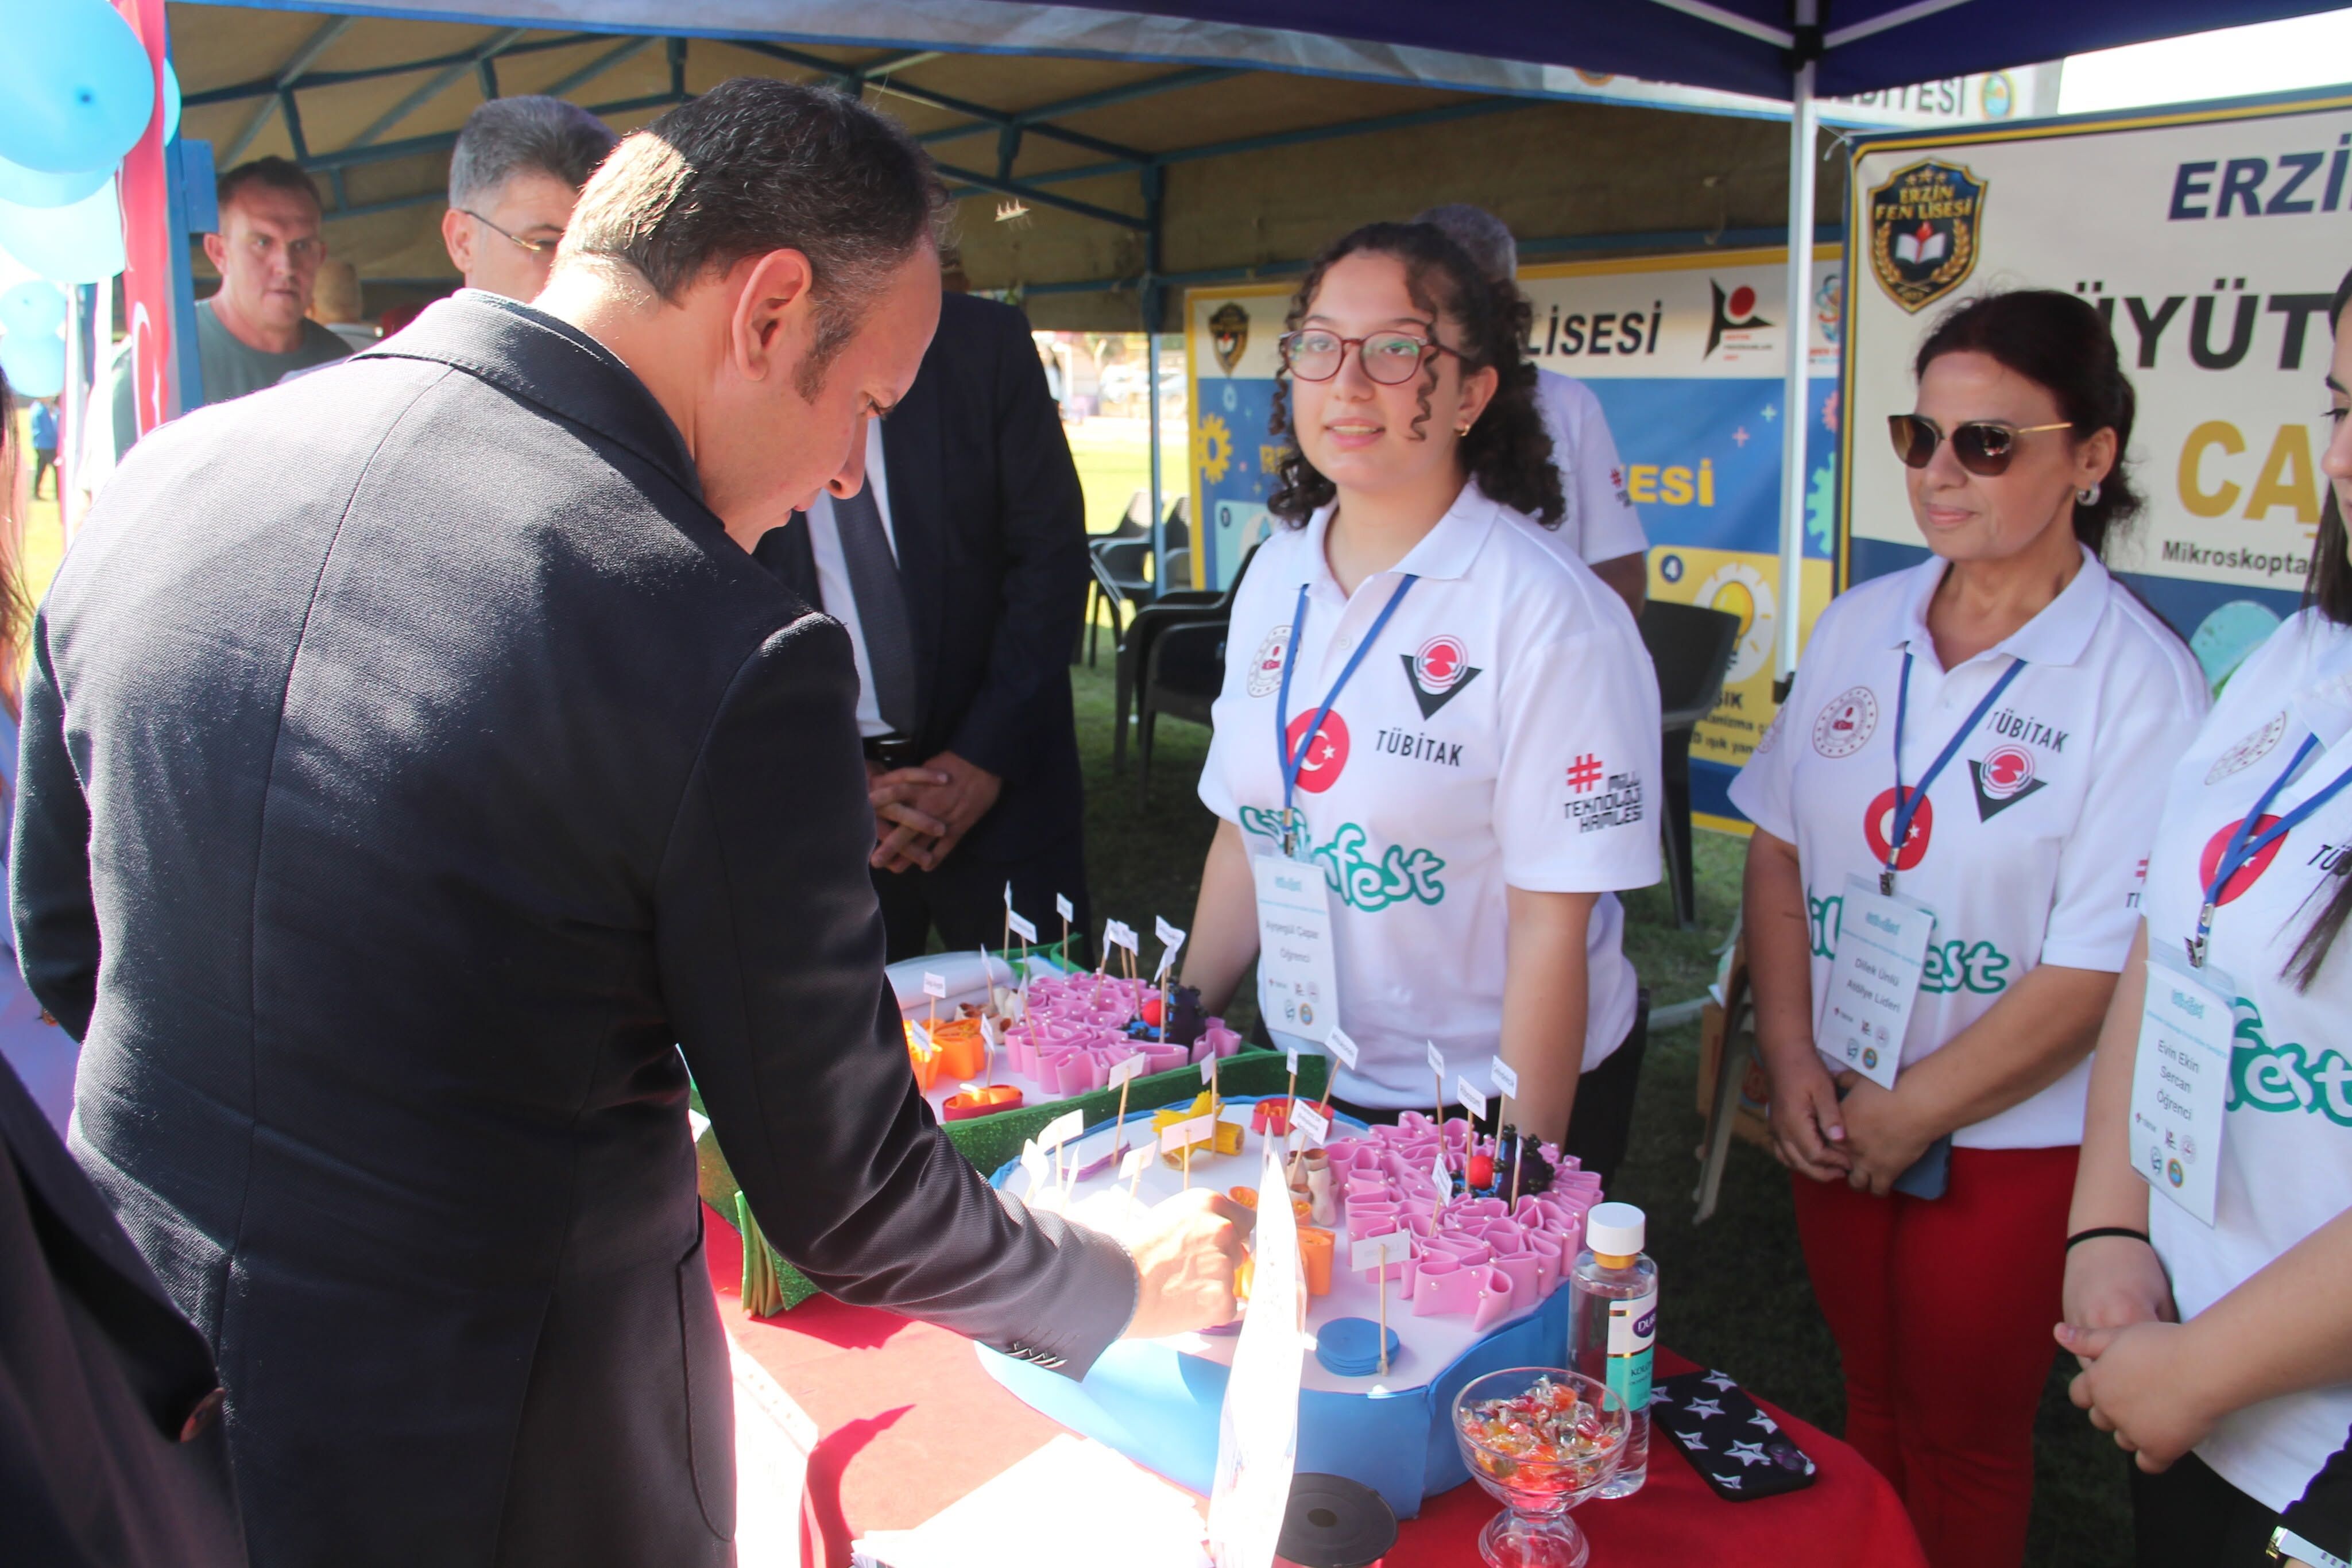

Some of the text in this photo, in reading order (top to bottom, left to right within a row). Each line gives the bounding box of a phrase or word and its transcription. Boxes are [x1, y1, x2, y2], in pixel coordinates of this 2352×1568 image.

[2168, 132, 2352, 222] ERZİ
[1875, 196, 1974, 220] FEN LİSESİ
[1898, 185, 1955, 204] ERZİN
[1665, 560, 1678, 579] 4
[1986, 707, 2069, 754] TÜBİTAK
[1376, 727, 1465, 768] TÜBİTAK
[1854, 957, 1877, 975] Dilek
[2157, 1039, 2199, 1074] Evin Ekin
[2159, 1065, 2191, 1093] Sercan
[2156, 1088, 2192, 1121] Öğrenci
